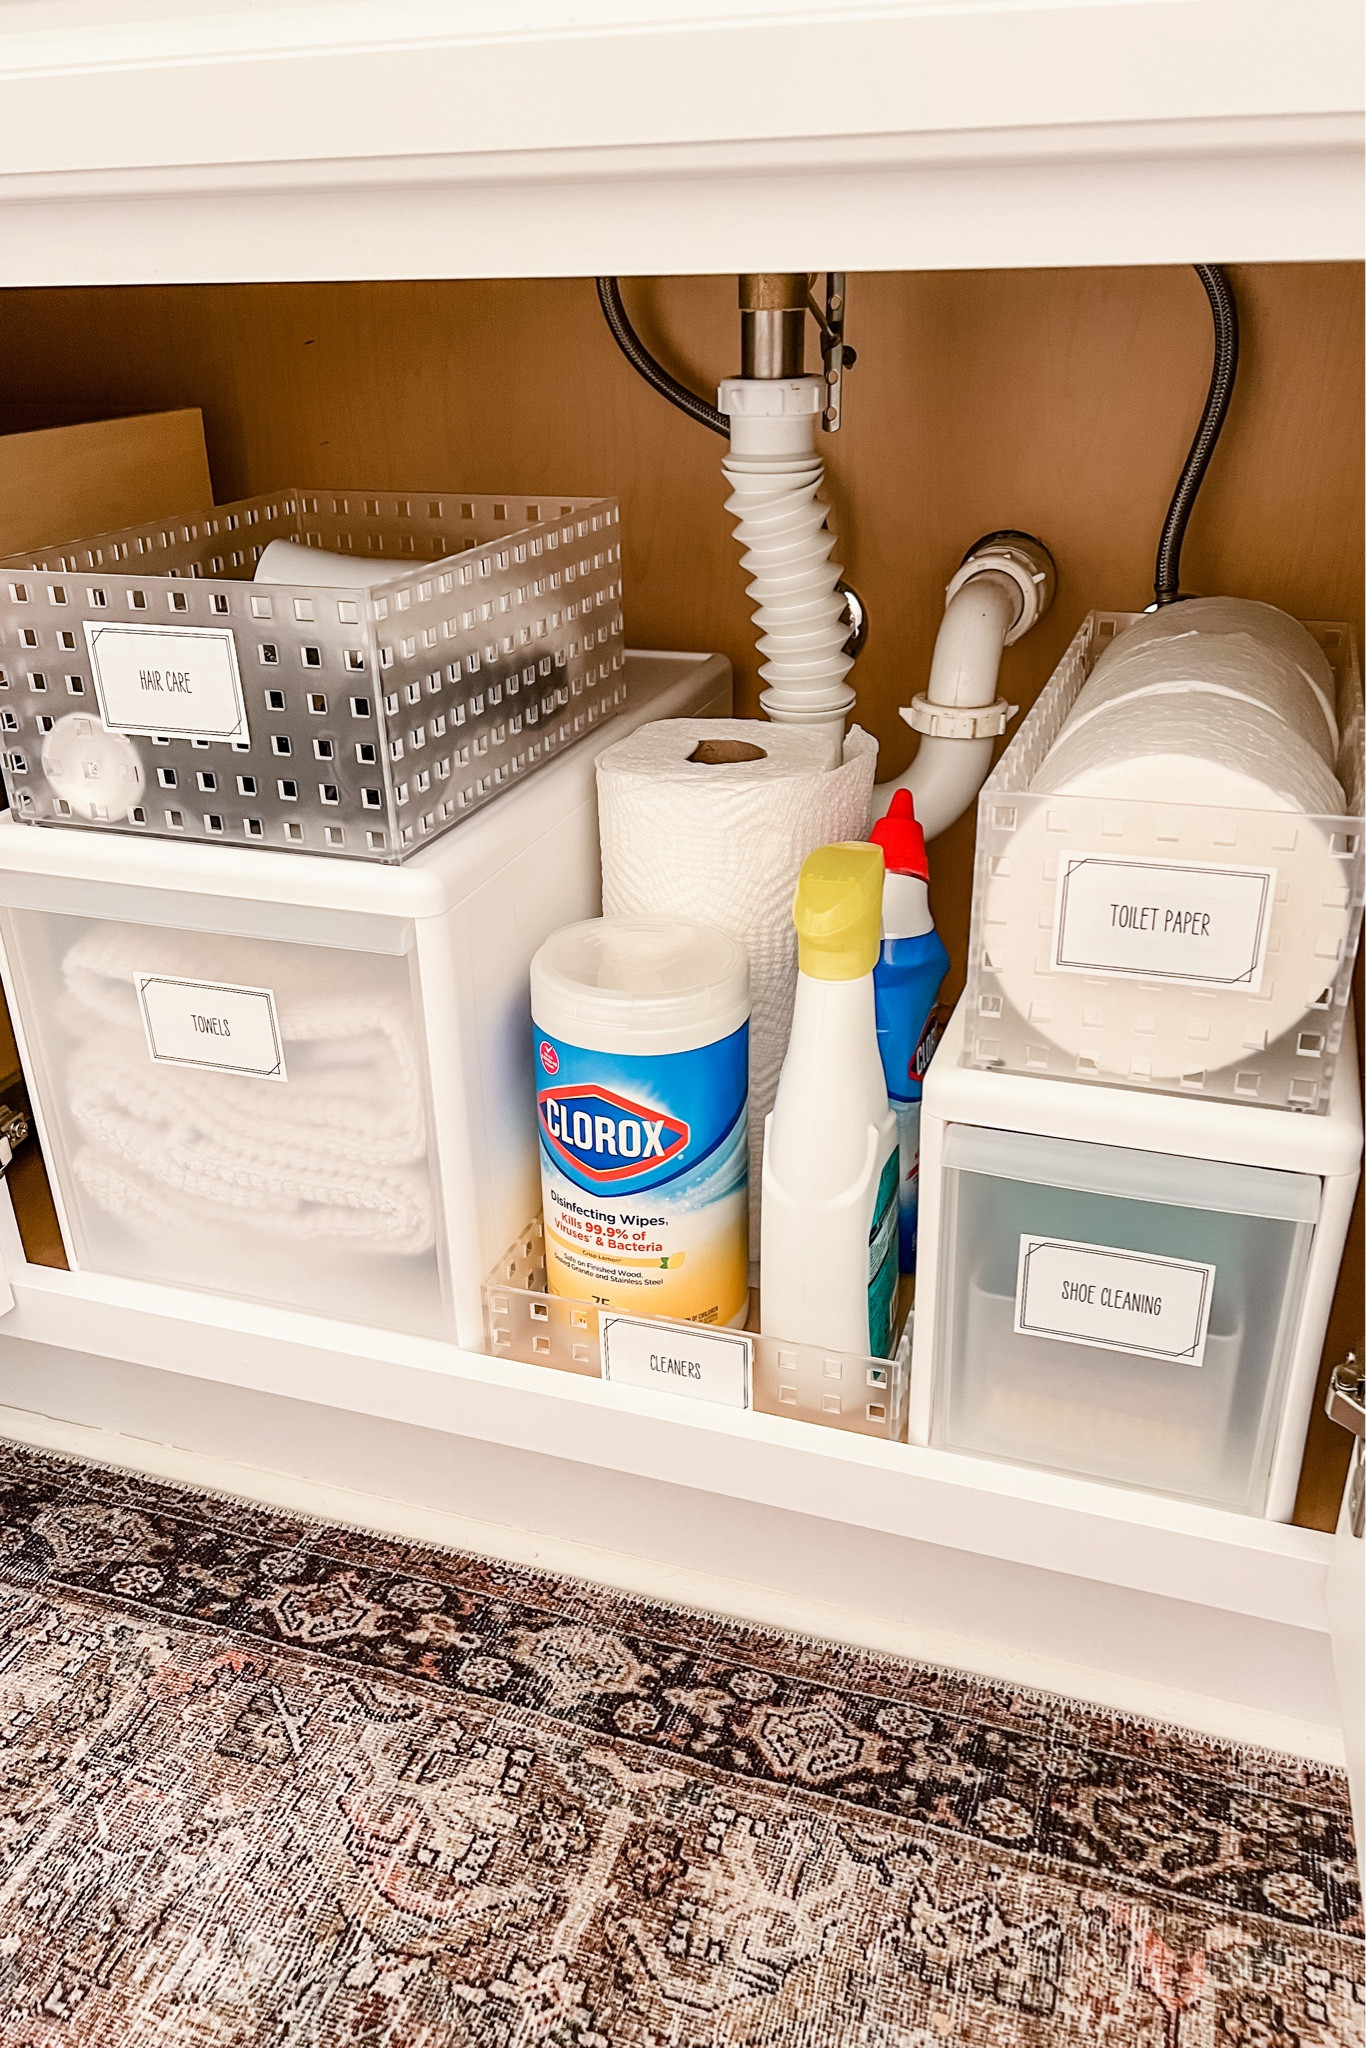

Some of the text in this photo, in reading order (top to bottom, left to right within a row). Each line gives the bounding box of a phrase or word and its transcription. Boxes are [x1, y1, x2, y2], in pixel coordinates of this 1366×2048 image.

[139, 669, 193, 694] HAIR CARE
[1110, 903, 1210, 937] TOILET PAPER
[190, 1014, 231, 1037] TOWELS
[546, 1097, 666, 1158] CLOROX
[550, 1189, 616, 1225] Disinfecting
[561, 1212, 647, 1241] Kills 99.9% of
[582, 1250, 598, 1260] Crisp
[595, 1236, 605, 1247] &
[608, 1239, 663, 1252] Bacteria
[563, 1252, 576, 1264] Safe
[577, 1259, 586, 1268] on
[586, 1262, 617, 1276] Finished
[571, 1263, 595, 1277] Granite
[595, 1272, 609, 1281] and
[610, 1275, 643, 1286] Stainless
[643, 1278, 664, 1286] Steel
[1061, 1280, 1162, 1316] SHOE CLEANING
[650, 1354, 702, 1380] CLEANERS
